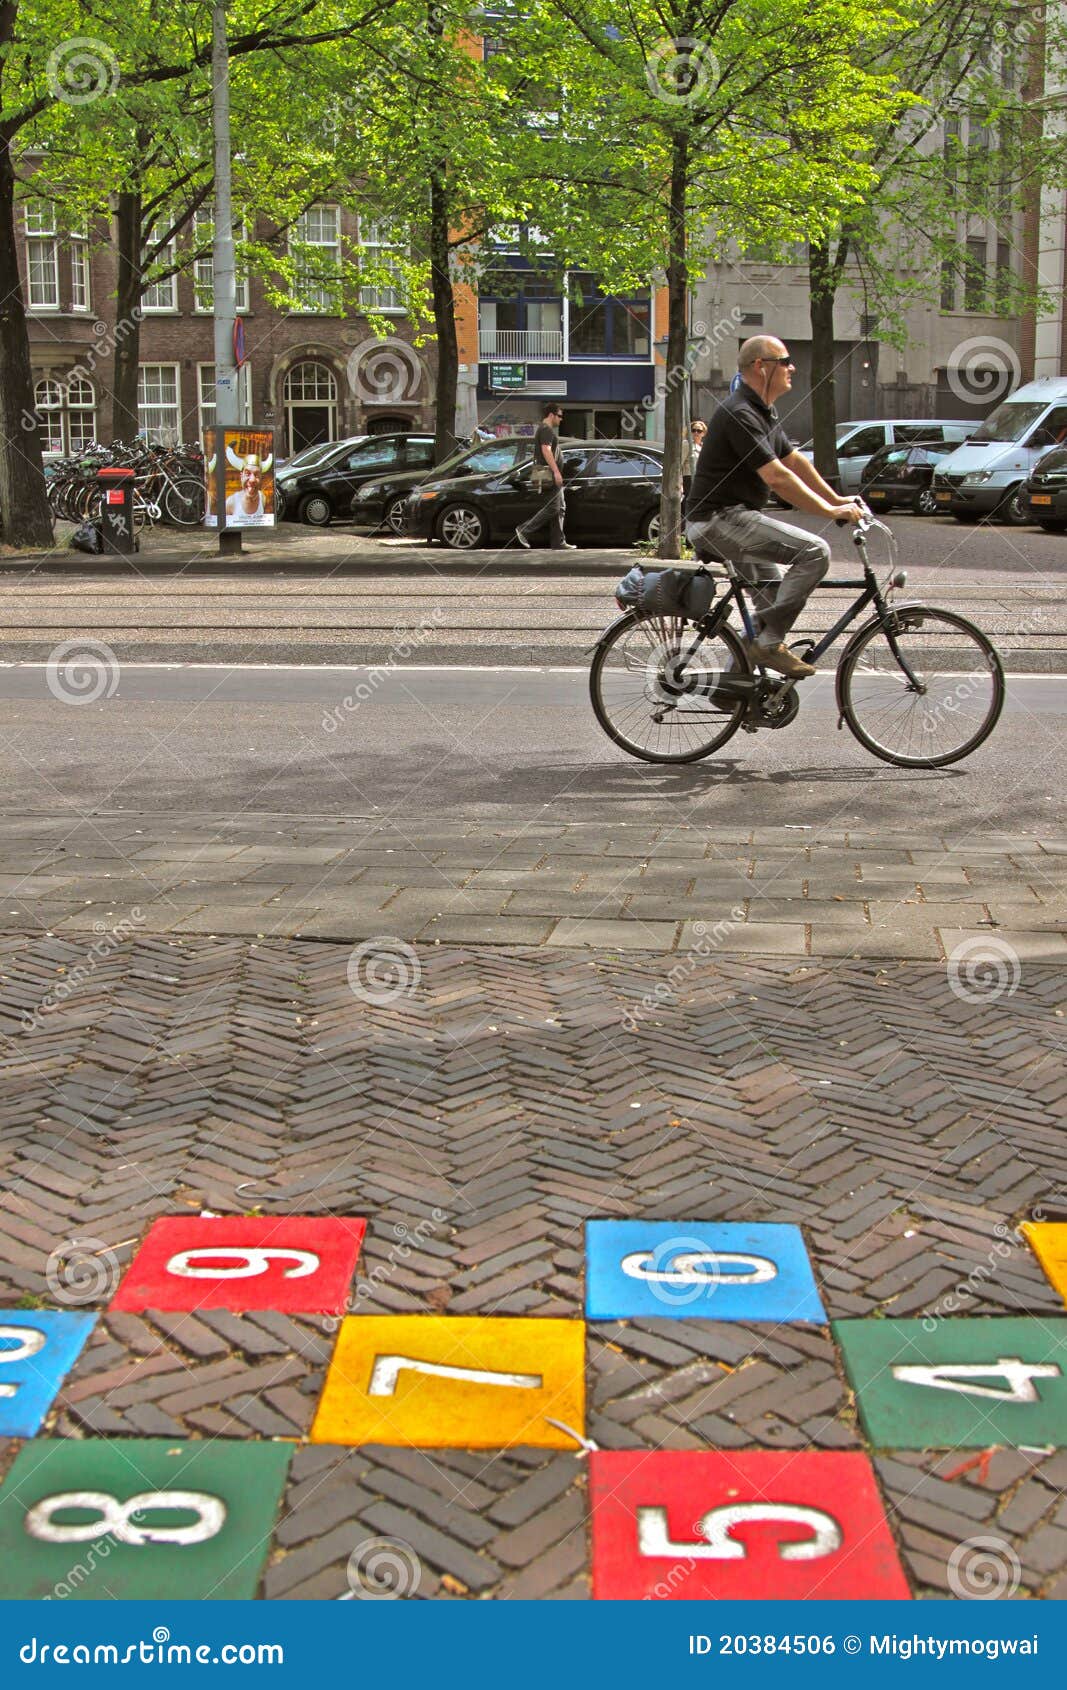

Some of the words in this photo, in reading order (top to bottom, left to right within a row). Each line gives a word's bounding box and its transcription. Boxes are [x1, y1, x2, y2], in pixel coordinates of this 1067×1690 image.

[367, 1353, 543, 1396] 7
[889, 1356, 1063, 1403] 4
[24, 1490, 227, 1546] 8
[633, 1503, 843, 1561] 5
